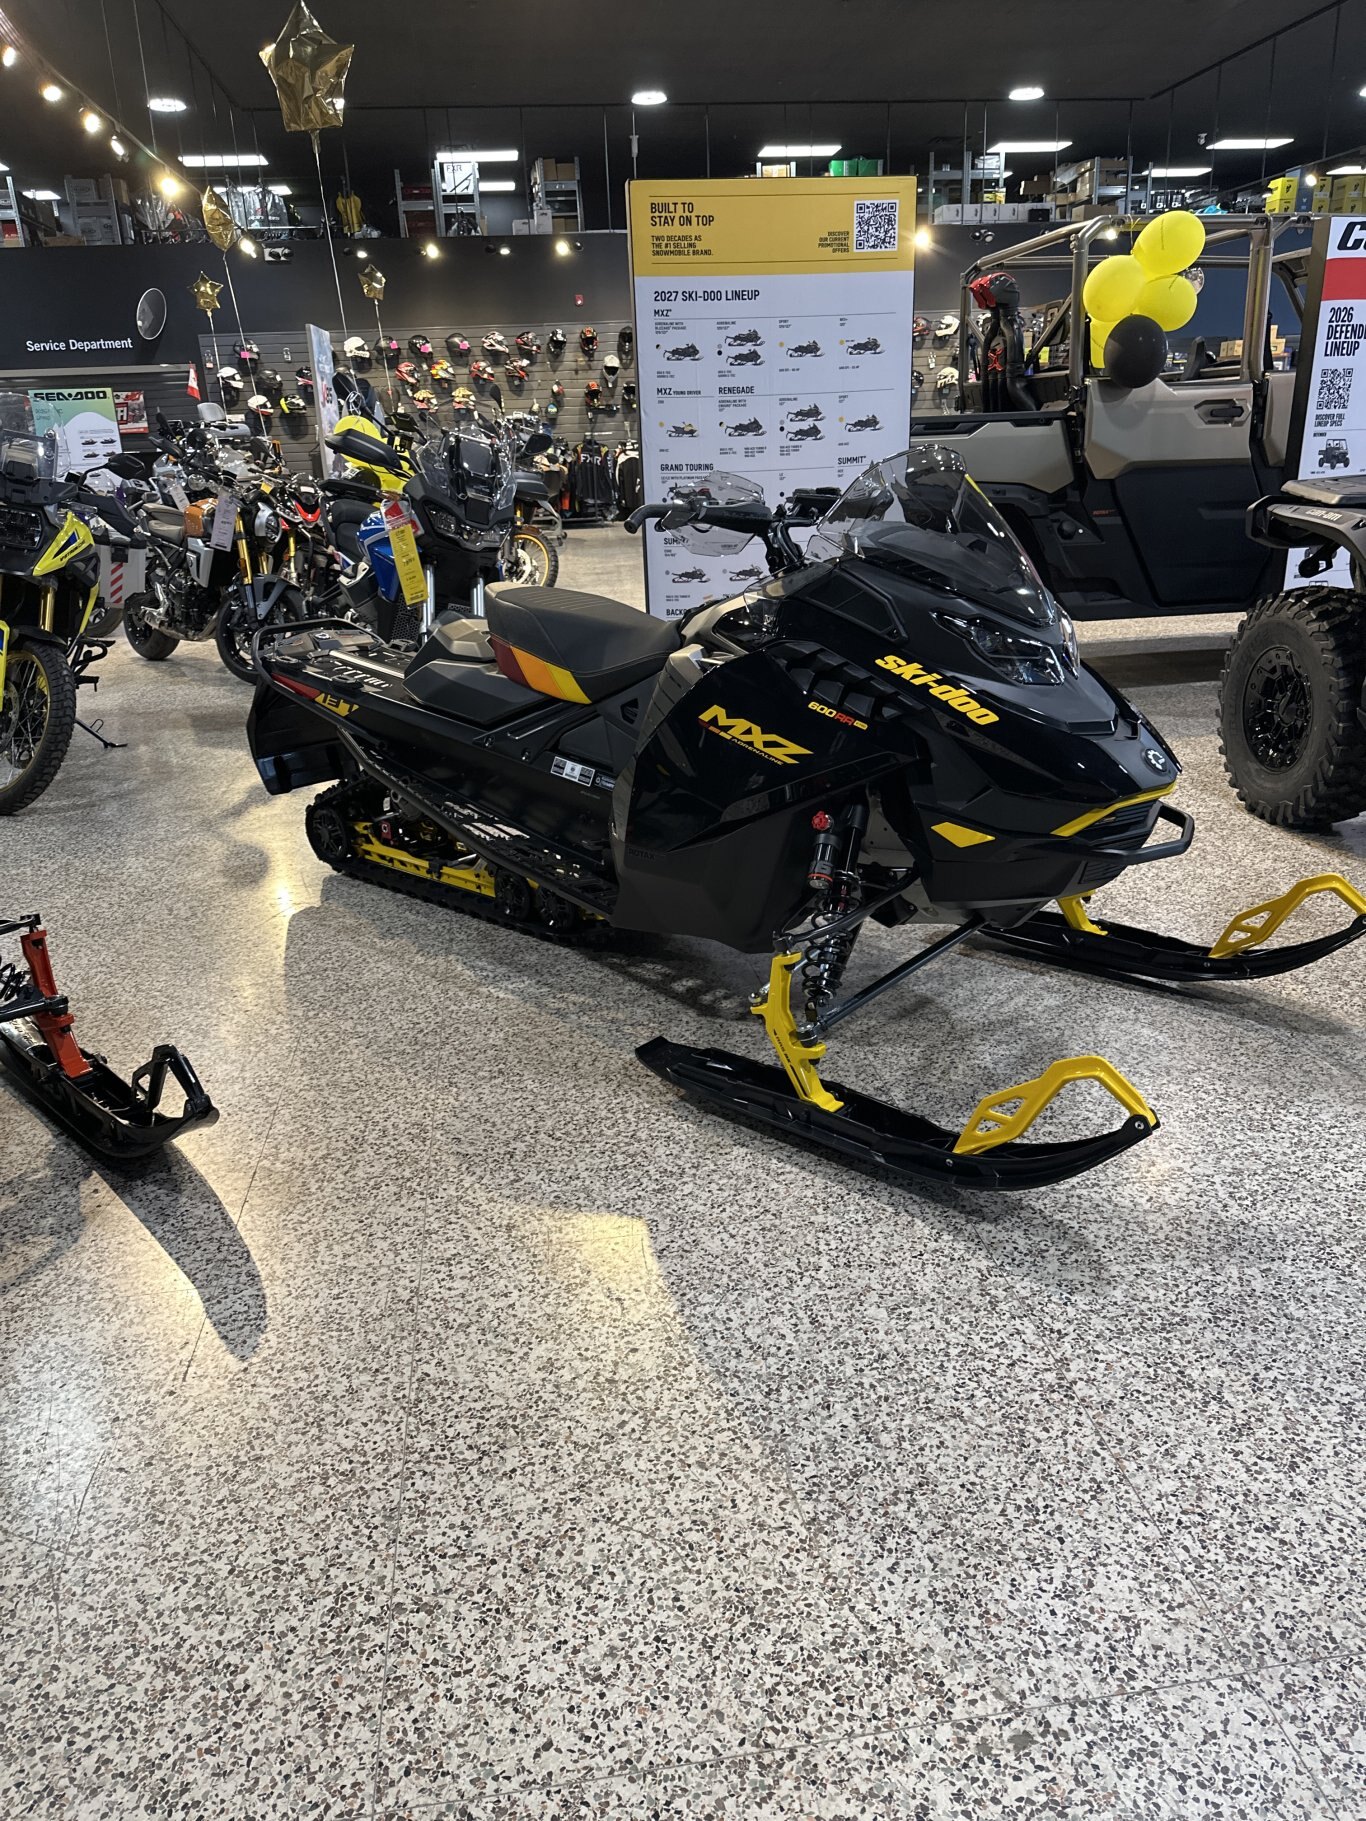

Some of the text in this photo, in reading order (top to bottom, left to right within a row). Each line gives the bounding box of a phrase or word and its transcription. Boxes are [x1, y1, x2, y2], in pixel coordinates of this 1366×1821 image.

[650, 202, 694, 214] BUILT TO
[650, 214, 715, 227] STAY ON TOP
[694, 234, 702, 242] AS
[653, 290, 760, 302] 2027 SKI-DOO LINEUP
[1328, 306, 1354, 324] 2026
[1326, 323, 1366, 340] DEFEND
[26, 337, 133, 352] Service Department
[1324, 340, 1360, 357] LINEUP
[656, 388, 672, 396] MXZ
[718, 386, 755, 394] RENEGADE
[1315, 413, 1336, 421] DISCOVER
[660, 463, 714, 472] GRAND TOURING
[874, 654, 1000, 726] ski-doo
[698, 704, 814, 764] MXZ
[731, 738, 785, 766] ADRENALINE
